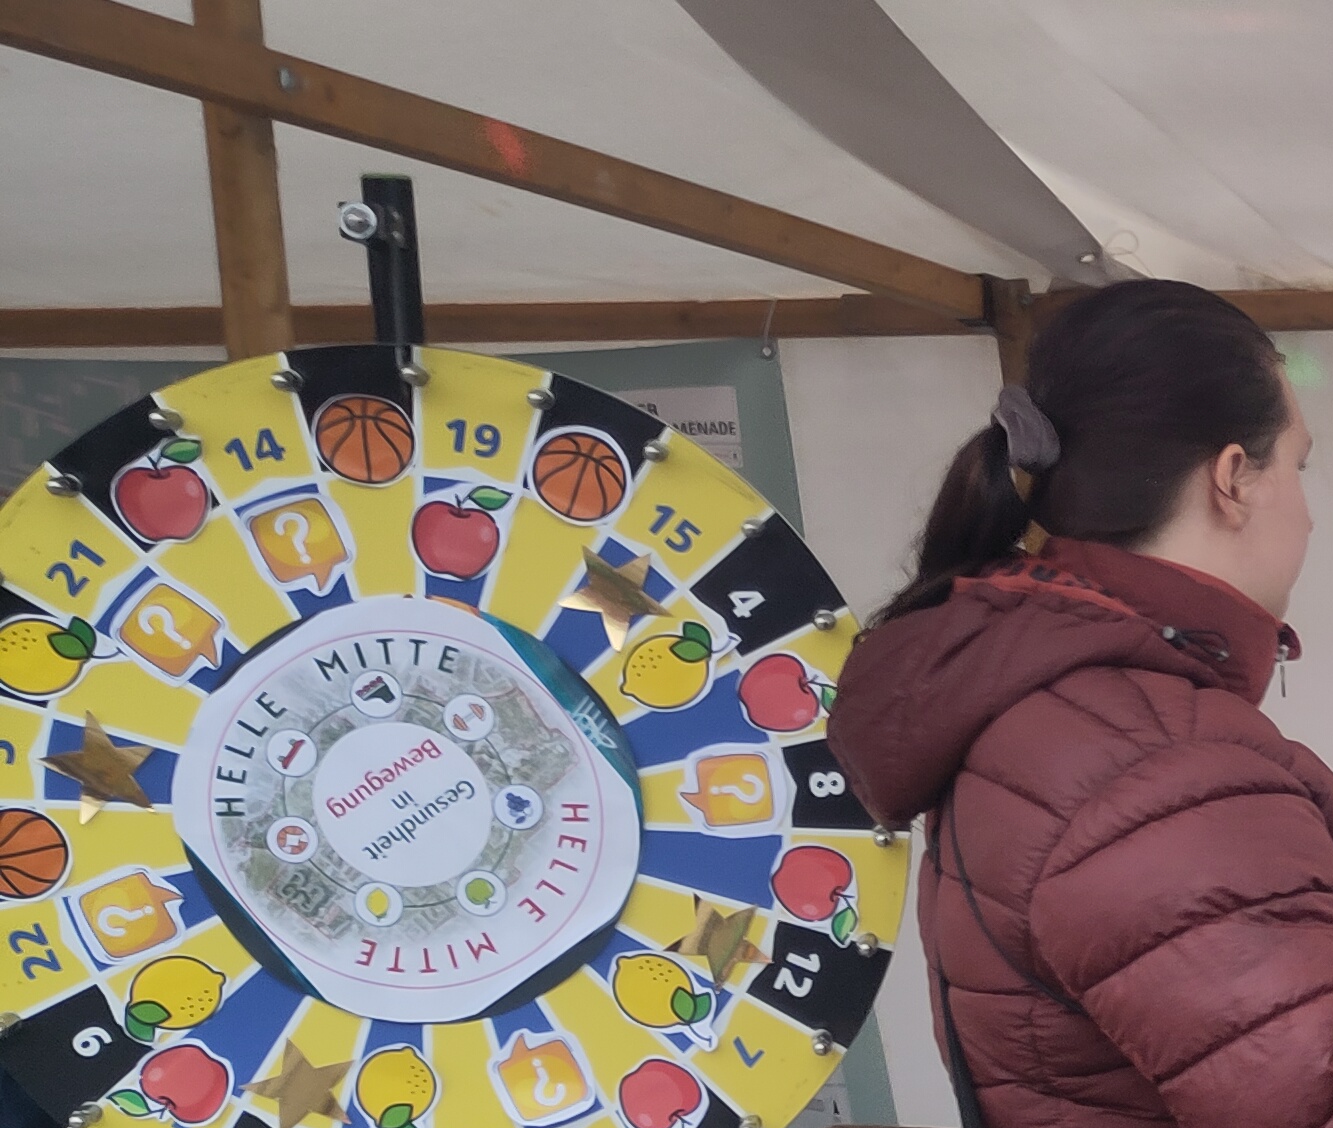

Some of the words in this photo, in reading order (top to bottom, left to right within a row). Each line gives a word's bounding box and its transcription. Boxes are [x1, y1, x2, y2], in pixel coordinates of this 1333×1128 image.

[224, 428, 287, 473] 14
[446, 418, 502, 458] 19
[673, 421, 737, 436] MENADE
[647, 503, 703, 554] 15
[46, 538, 107, 599] 21
[726, 587, 764, 619] 4
[312, 636, 462, 682] MITTE
[214, 690, 290, 818] HELLE
[325, 738, 443, 820] Bewegung
[390, 789, 417, 812] in
[809, 770, 846, 798] 8
[360, 779, 477, 862] Gesundheit
[516, 802, 591, 923] HELLE
[20, 922, 62, 982] 22
[354, 932, 499, 975] MITTE
[771, 952, 821, 998] 12
